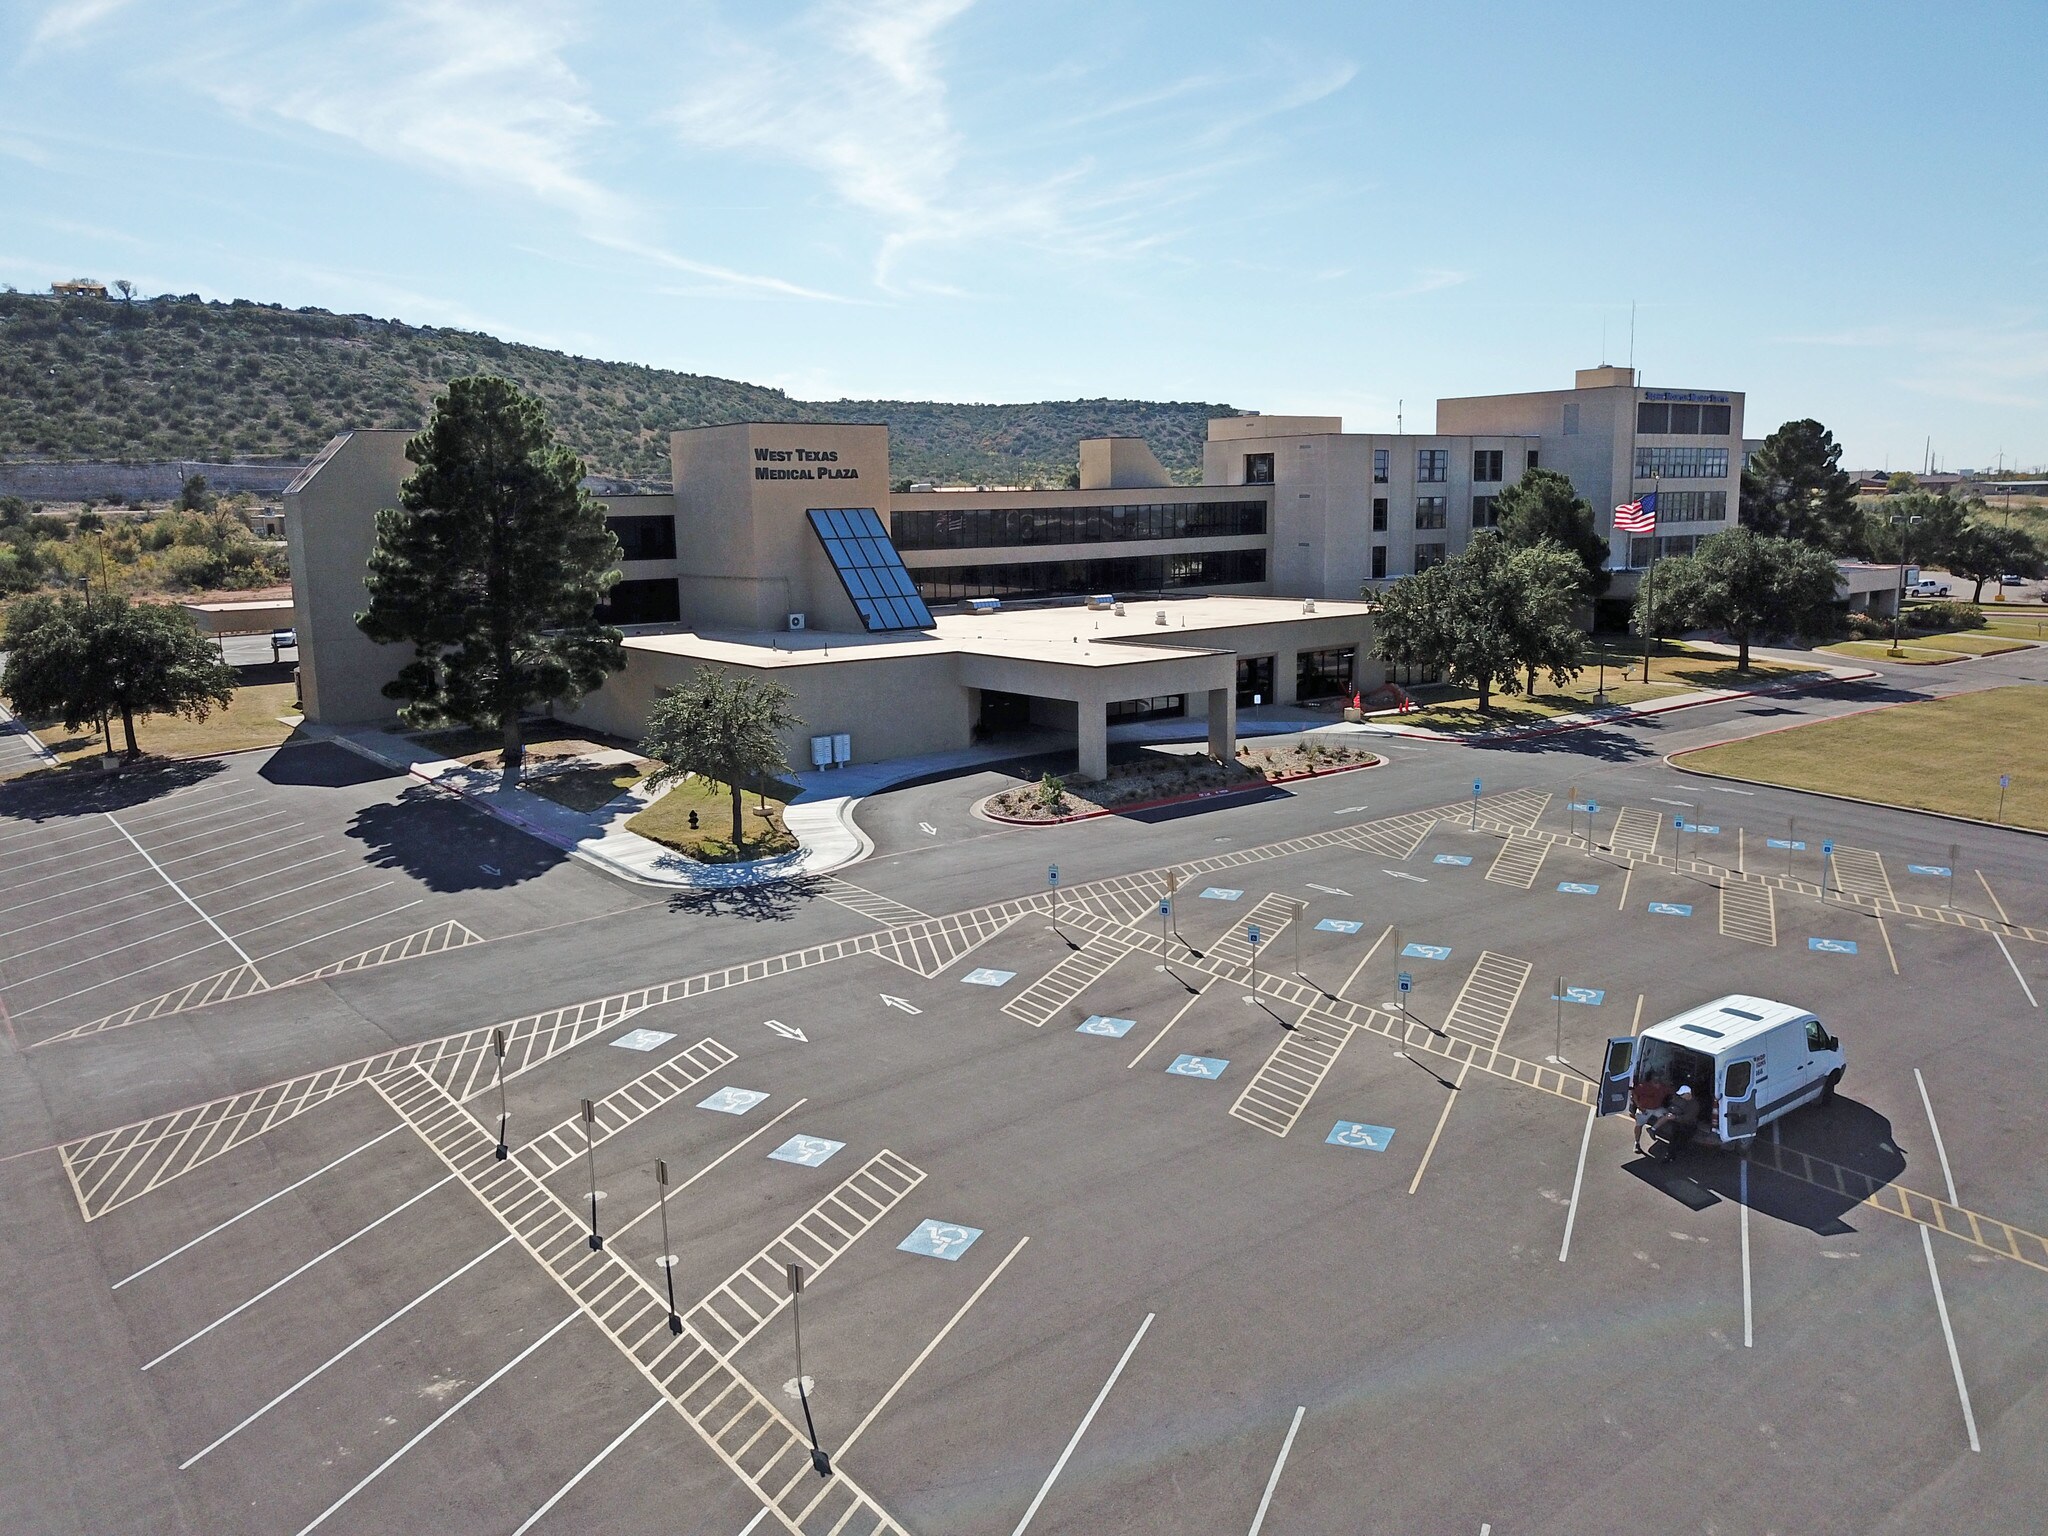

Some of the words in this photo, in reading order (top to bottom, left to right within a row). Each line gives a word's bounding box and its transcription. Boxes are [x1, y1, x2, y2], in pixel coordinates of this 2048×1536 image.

[754, 448, 793, 461] WEST
[795, 448, 838, 462] TEXAS
[755, 467, 815, 480] MEDICAL
[817, 466, 859, 479] PLAZA
